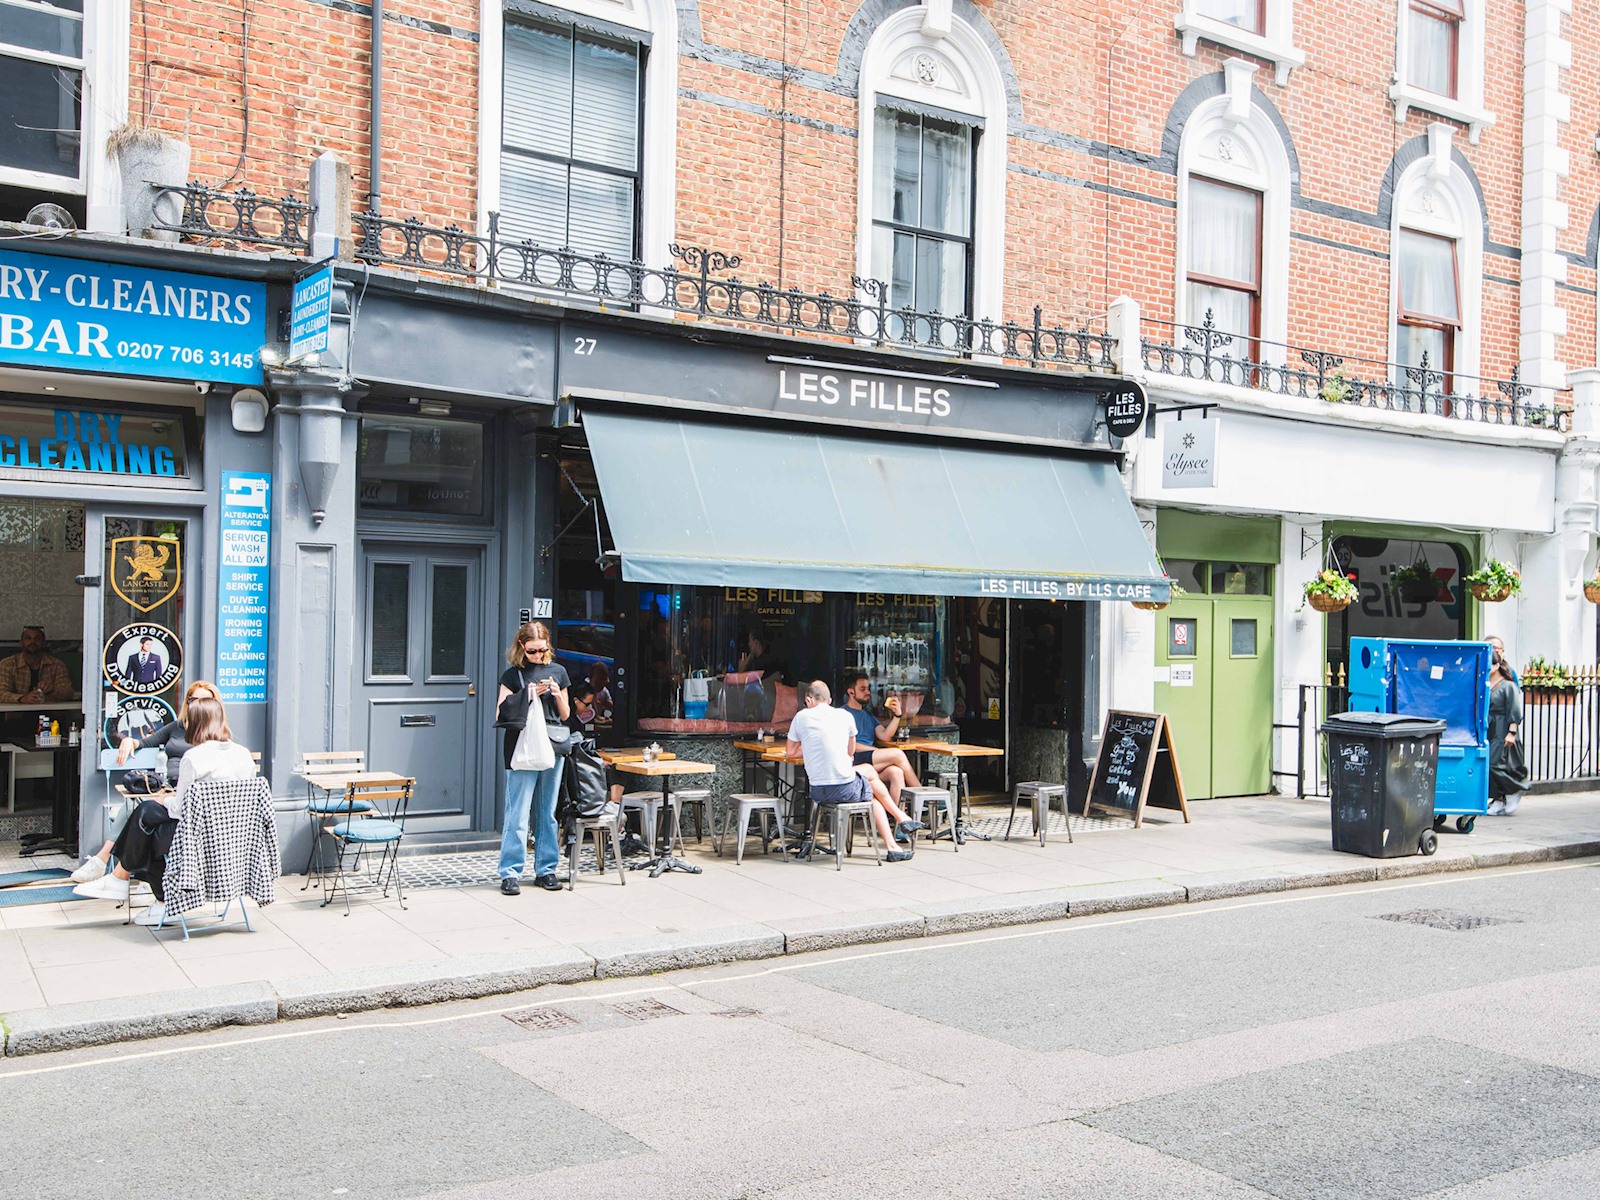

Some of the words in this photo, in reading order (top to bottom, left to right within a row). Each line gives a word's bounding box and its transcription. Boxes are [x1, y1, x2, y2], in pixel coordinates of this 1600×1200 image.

[295, 277, 329, 308] LANCASTER
[0, 313, 114, 359] BAR
[116, 341, 164, 360] 0207
[170, 346, 204, 364] 706
[209, 351, 253, 369] 3145
[573, 336, 597, 356] 27
[778, 370, 839, 405] LES
[850, 379, 951, 417] FILLES
[1116, 392, 1135, 405] LES
[1108, 403, 1142, 417] FILLES
[53, 408, 124, 445] DRY
[0, 436, 176, 477] CLEANING
[1165, 453, 1208, 476] Elysee
[224, 511, 269, 520] ALTERATION
[230, 519, 262, 527] SERVICE
[225, 533, 266, 543] SERVICE
[231, 544, 260, 553] WASH
[224, 554, 243, 563] ALL
[246, 555, 265, 564] DAY
[231, 573, 258, 581] SHIRT
[122, 580, 169, 588] LANCASTER
[225, 582, 263, 591] SERVICE
[981, 578, 1008, 593] LES
[1013, 580, 1062, 597] FILLES,
[1066, 582, 1084, 596] BY
[1088, 583, 1112, 597] LLS
[1116, 584, 1151, 598] CAFE
[229, 596, 259, 604] DUVET
[725, 587, 759, 602] LES
[768, 588, 824, 604] FILLES
[856, 592, 886, 606] LES
[894, 593, 942, 607] FILLES
[221, 605, 267, 614] CLEANING
[537, 600, 550, 616] 27
[225, 619, 263, 627] IRONING
[122, 626, 169, 641] Expert
[224, 628, 262, 637] SERVICE
[234, 643, 252, 651] DRY
[220, 652, 265, 661] CLEANING
[219, 668, 238, 676] BED
[239, 668, 265, 677] LINEN
[219, 678, 265, 687] CLEANING
[117, 698, 168, 717] Service
